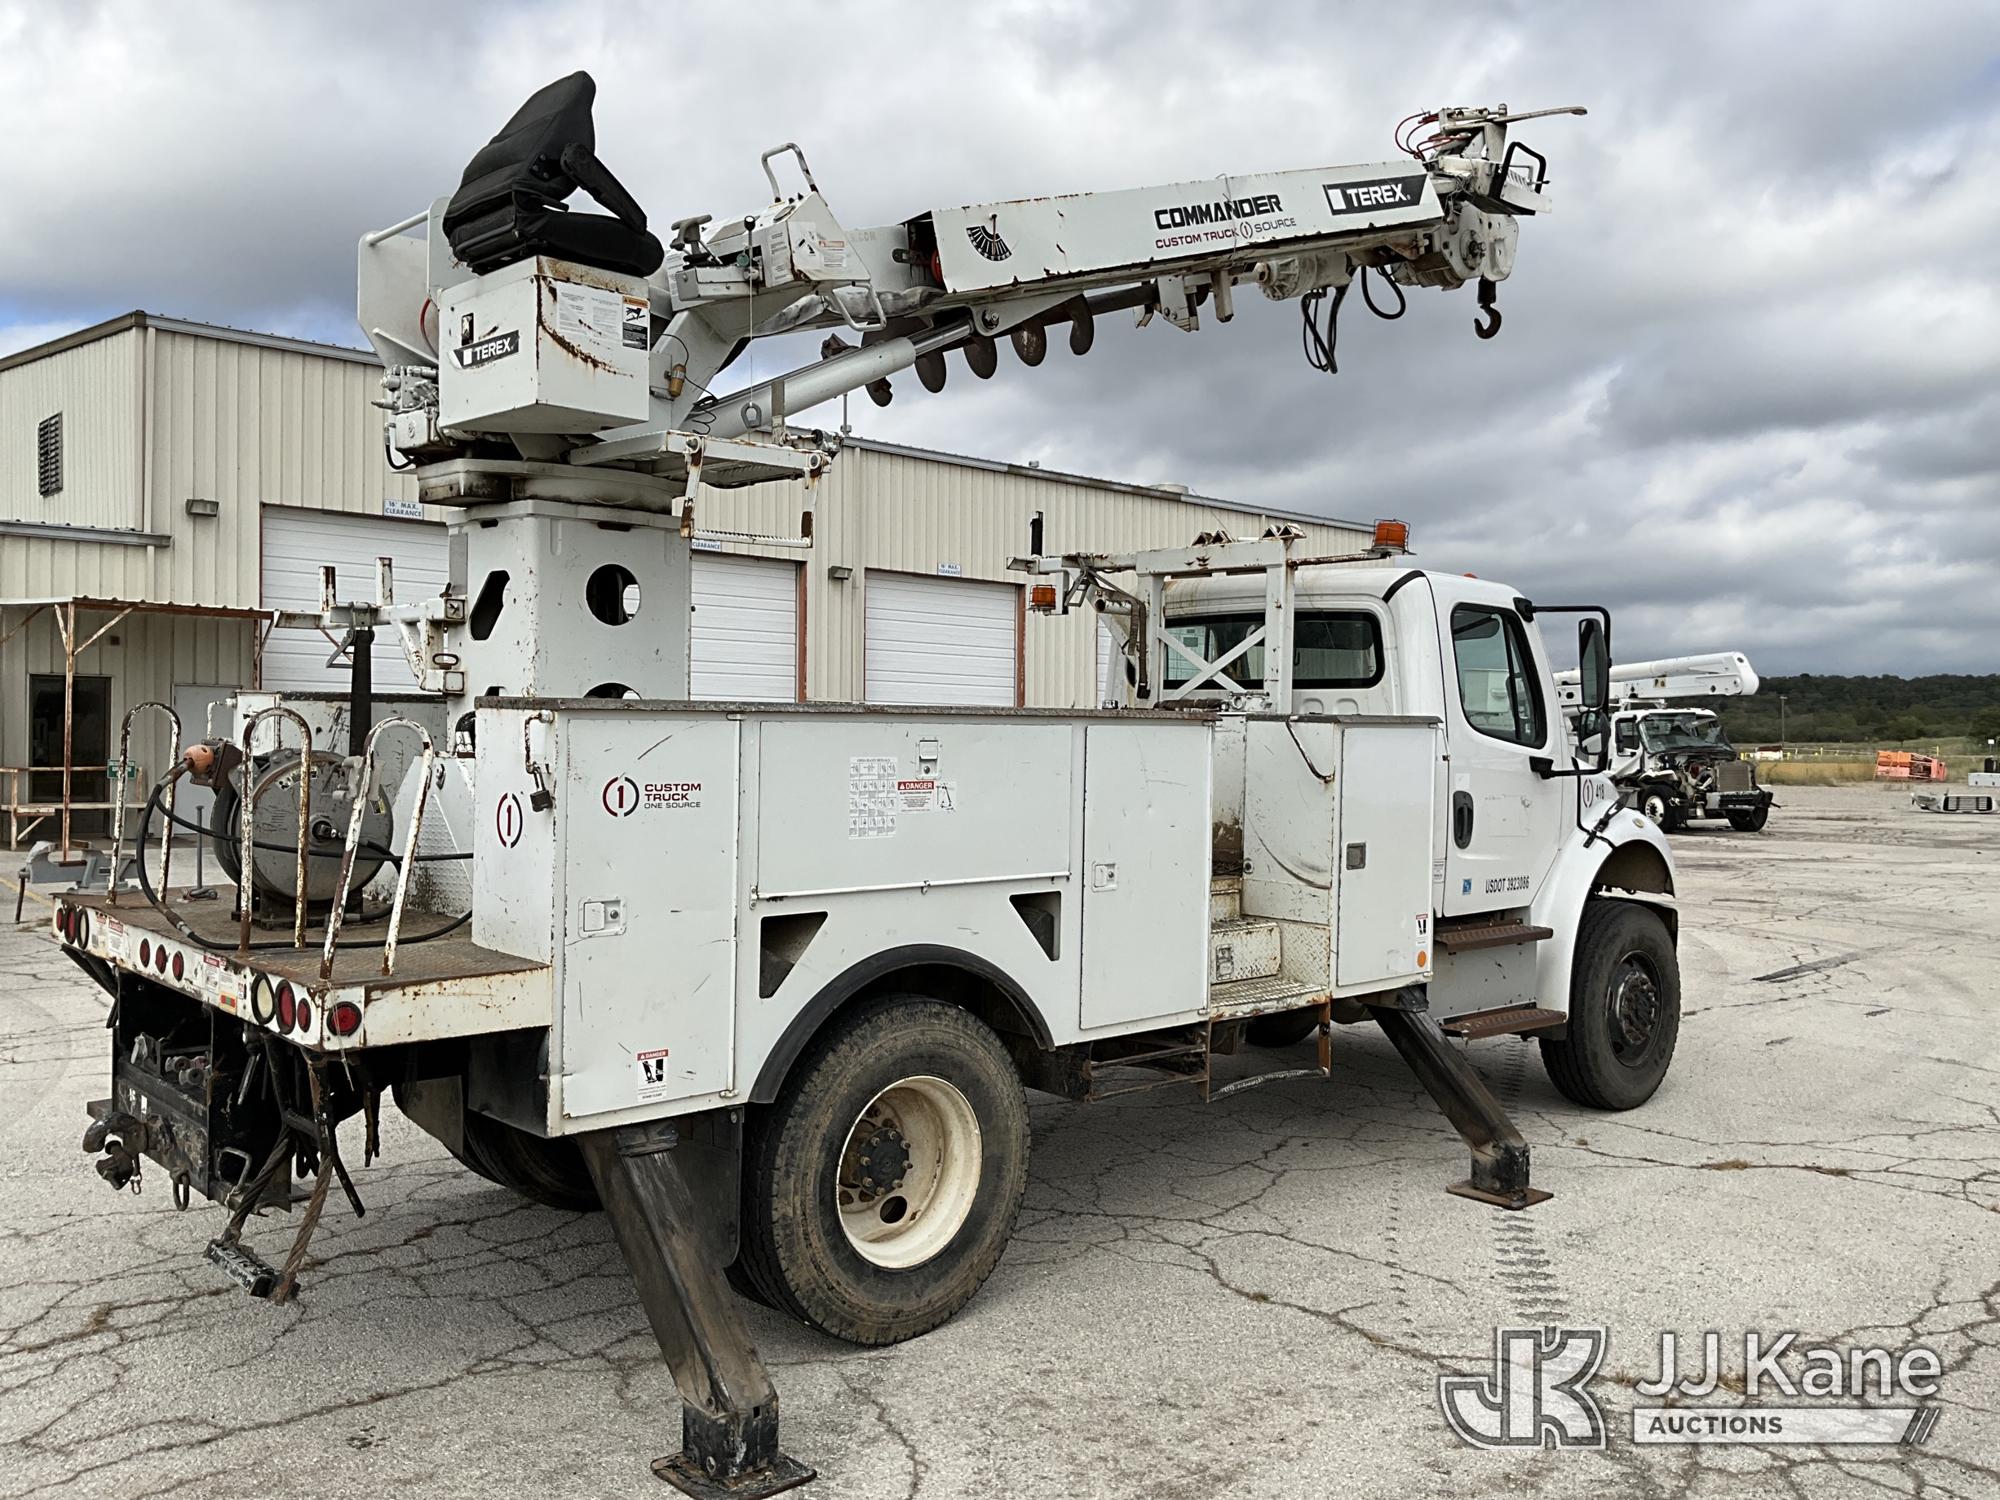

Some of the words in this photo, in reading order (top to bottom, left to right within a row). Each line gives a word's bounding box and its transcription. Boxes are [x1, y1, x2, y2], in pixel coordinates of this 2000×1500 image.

[1346, 183, 1407, 207] TEREX
[1154, 194, 1283, 230] COMMANDER
[1155, 233, 1202, 249] CUSTOM
[1203, 228, 1239, 241] TRUCK
[1254, 217, 1297, 233] SOURCE
[474, 337, 511, 361] TEREX
[385, 508, 421, 516] CLEARANCE
[644, 783, 702, 792] CUSTOM
[905, 782, 933, 790] DANGER
[644, 793, 689, 802] TRUCK
[665, 801, 701, 809] SOURCE
[1485, 878, 1506, 894] USDOT
